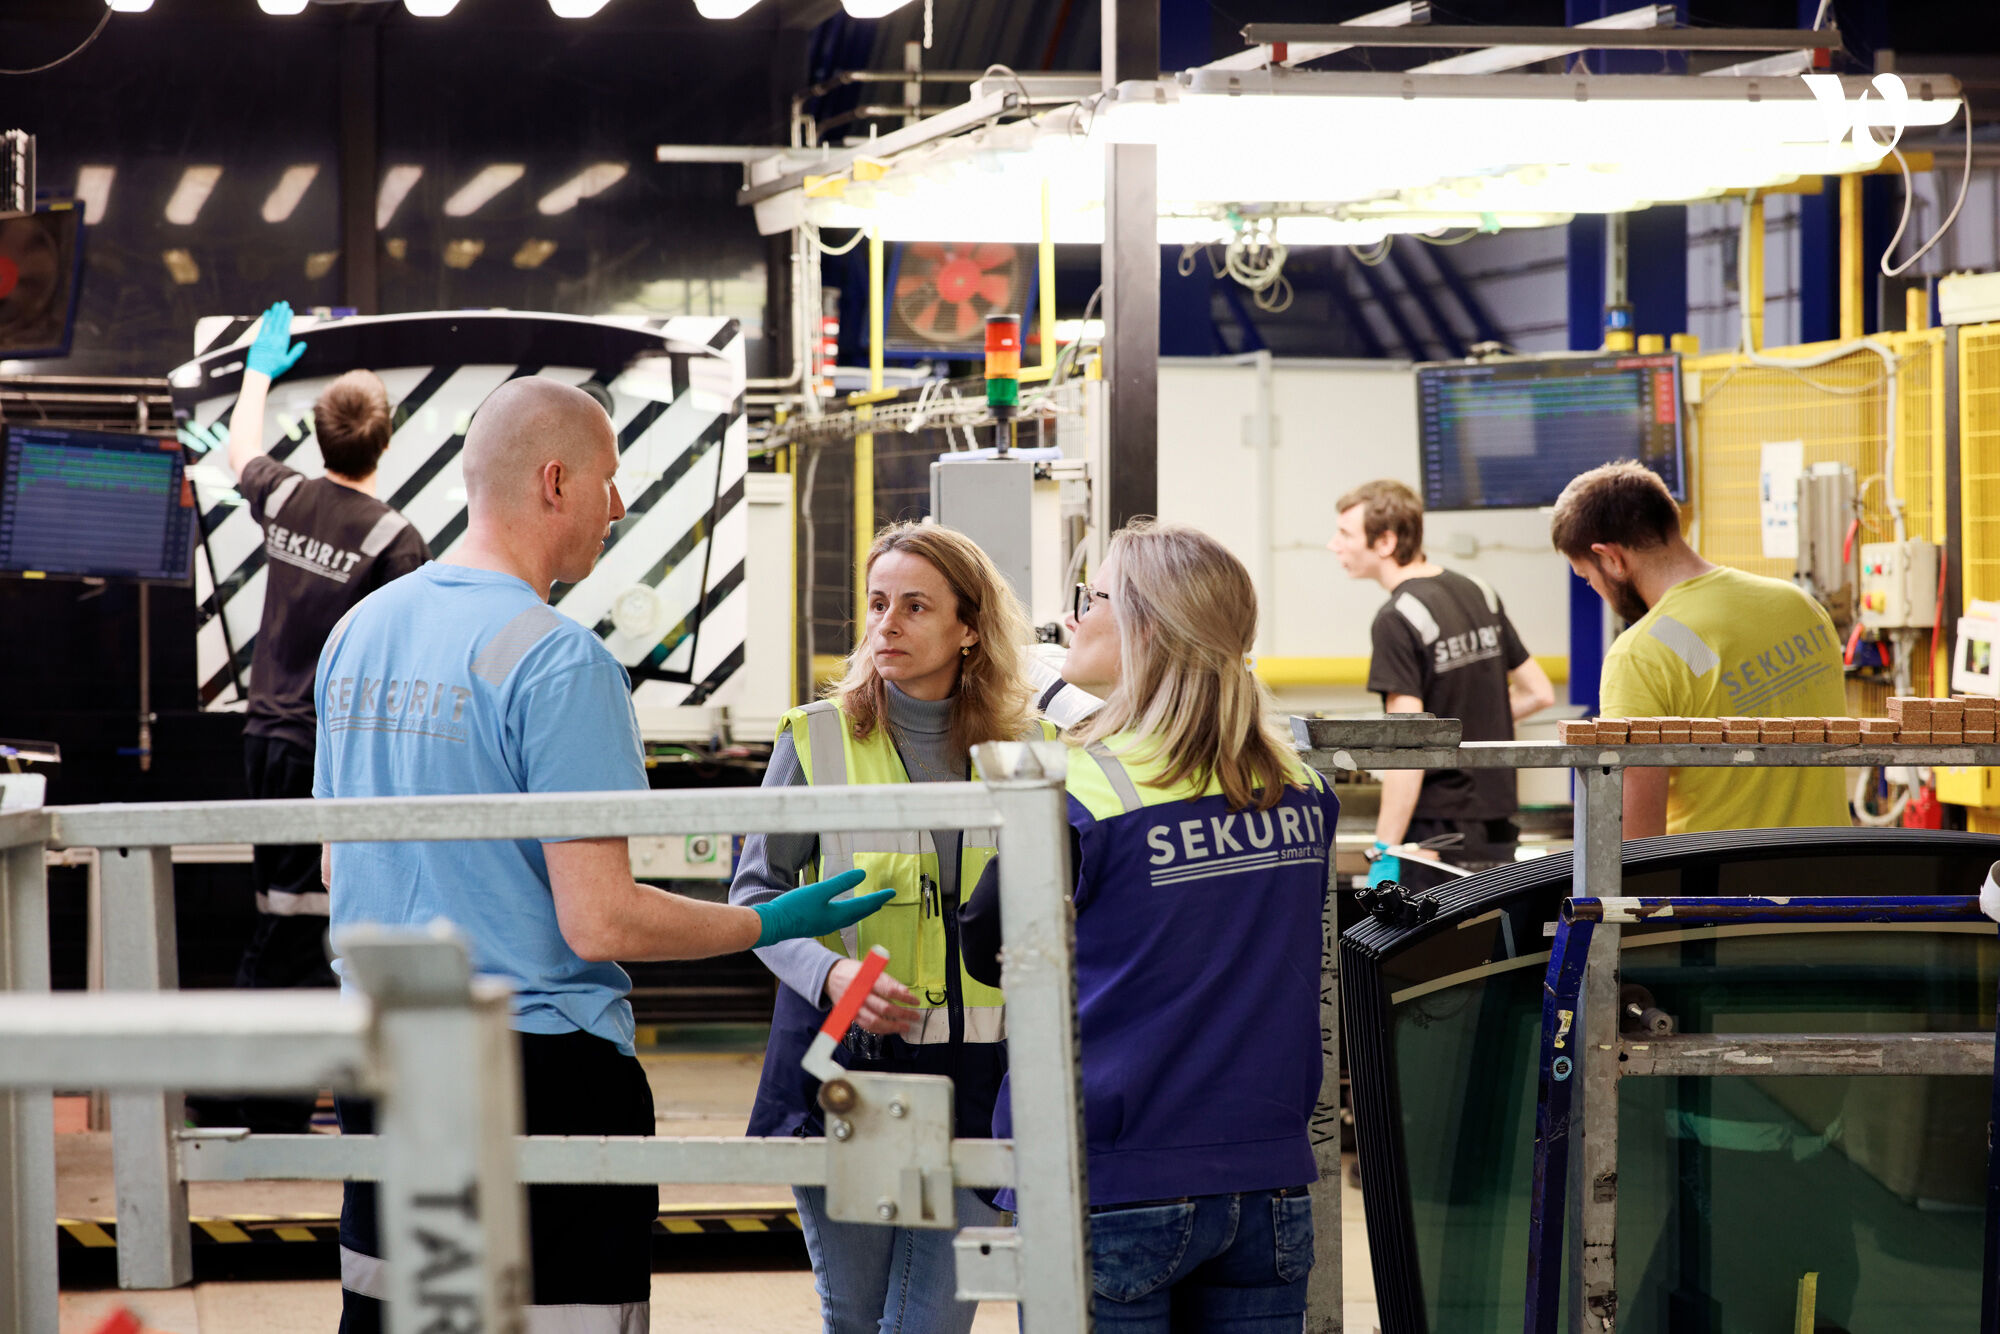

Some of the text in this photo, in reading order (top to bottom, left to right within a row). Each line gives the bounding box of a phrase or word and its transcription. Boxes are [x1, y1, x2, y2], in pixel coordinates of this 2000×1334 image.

[267, 523, 361, 573] SEKURIT
[1721, 624, 1831, 697] SEKURIT
[328, 677, 473, 722] SEKURIT
[1280, 845, 1311, 860] smart
